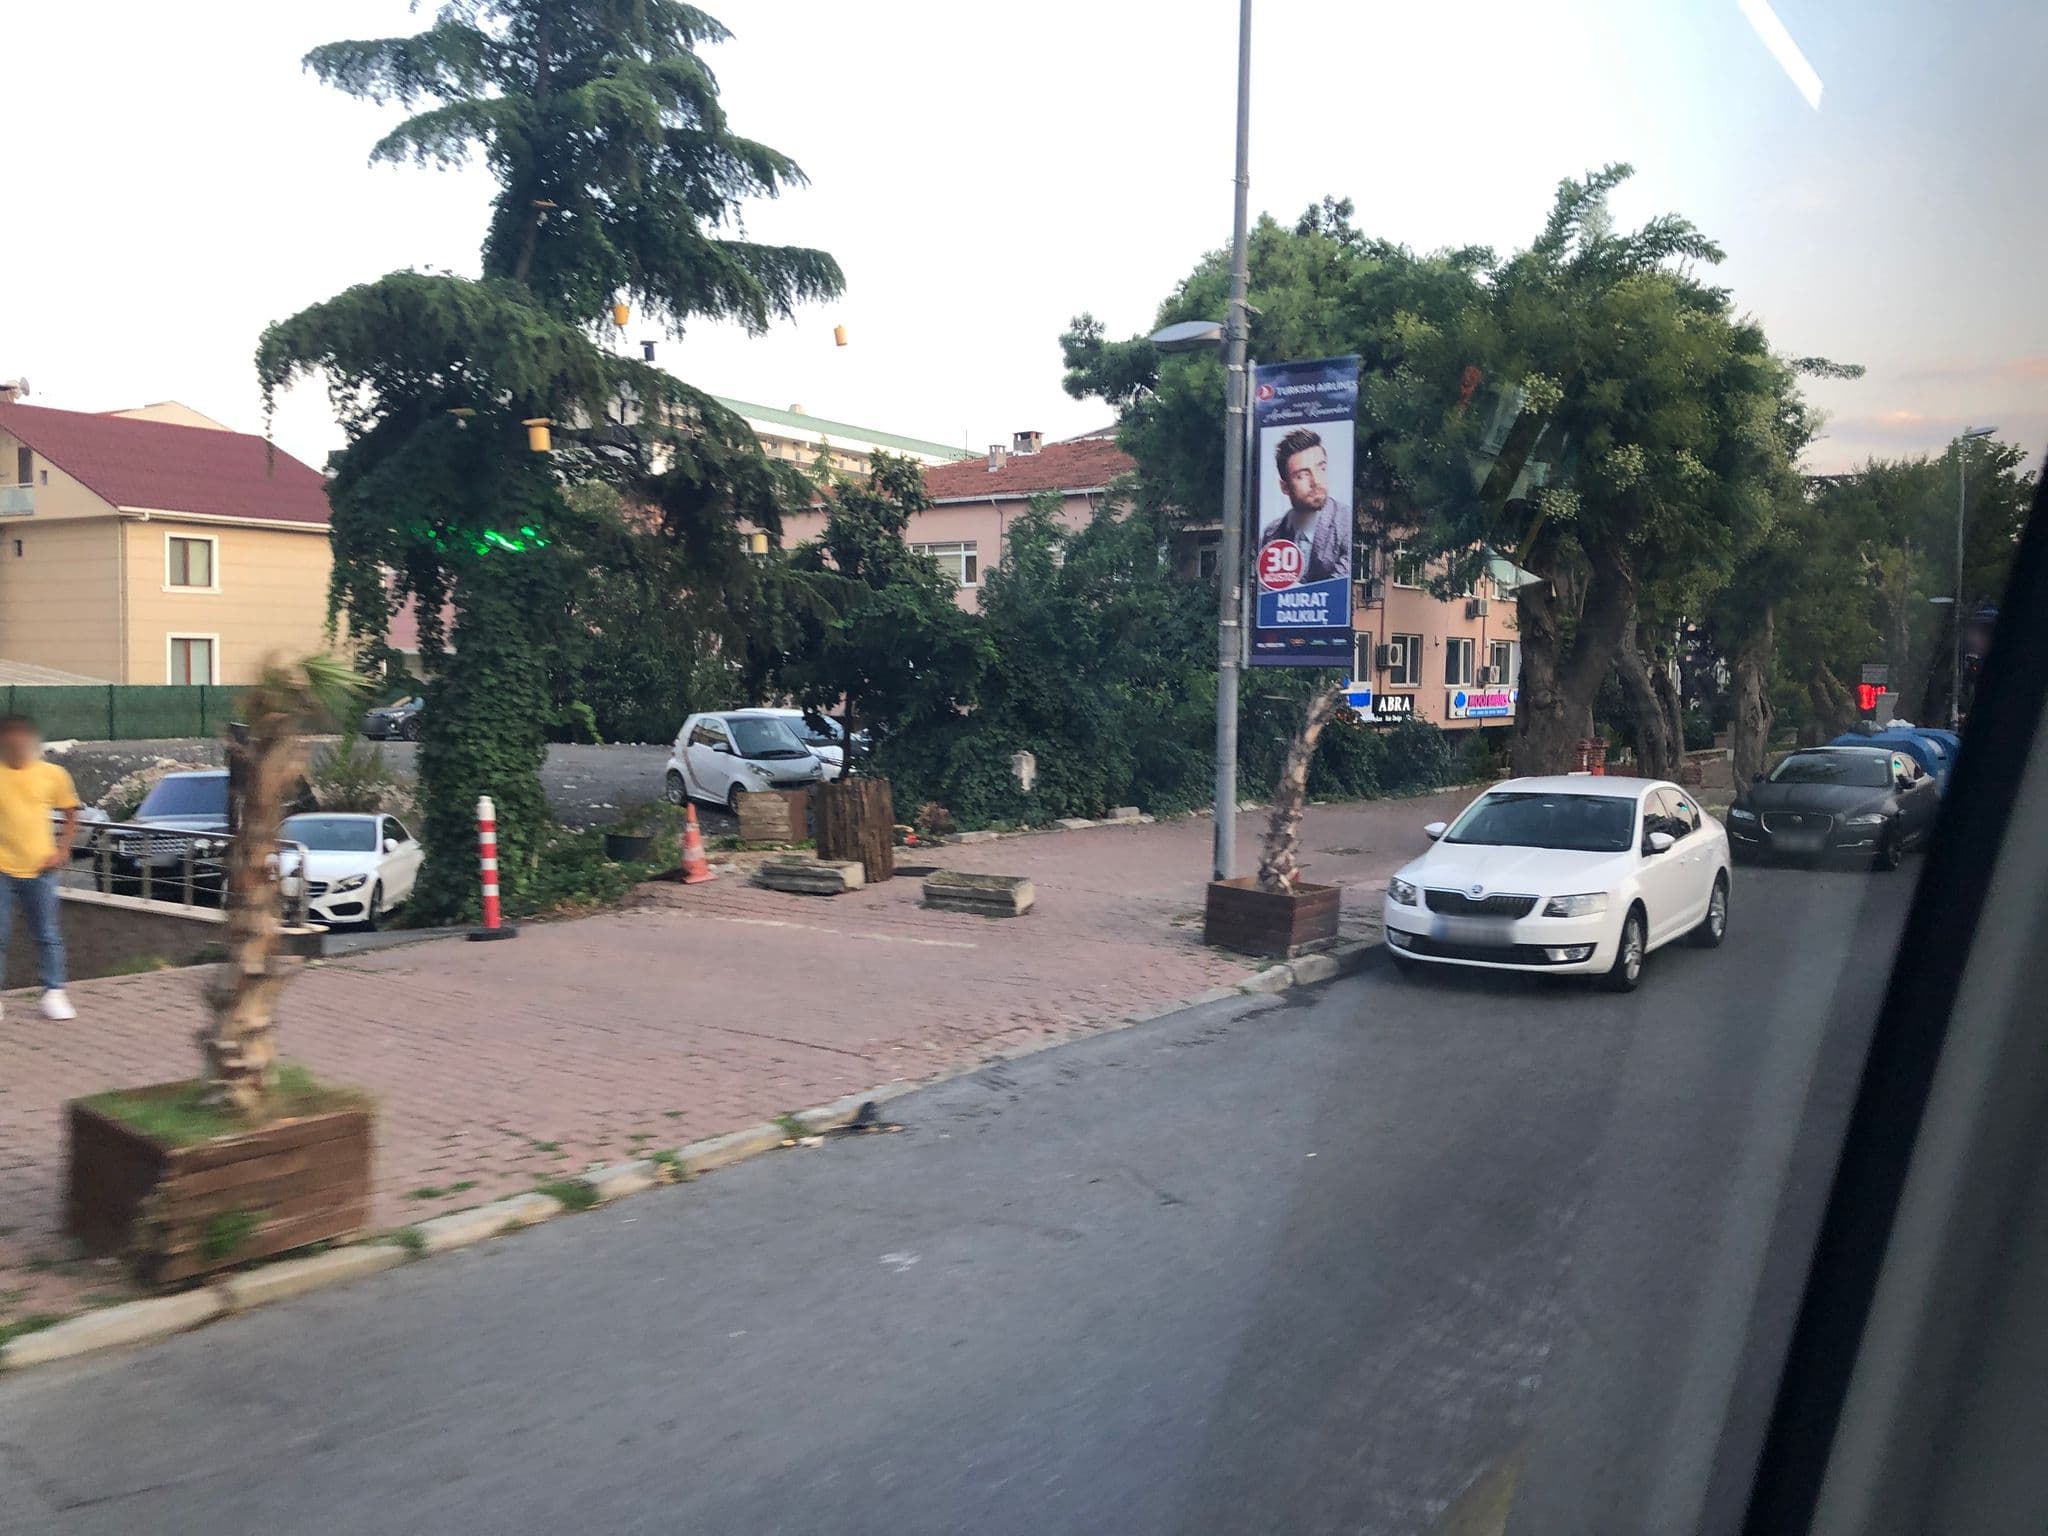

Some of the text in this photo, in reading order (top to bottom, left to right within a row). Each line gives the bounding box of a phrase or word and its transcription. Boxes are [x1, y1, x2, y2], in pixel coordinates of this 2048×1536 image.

[1276, 385, 1316, 396] TURKISH
[1266, 547, 1299, 572] 30
[1277, 592, 1329, 608] MURAT
[1378, 696, 1411, 712] ABRA
